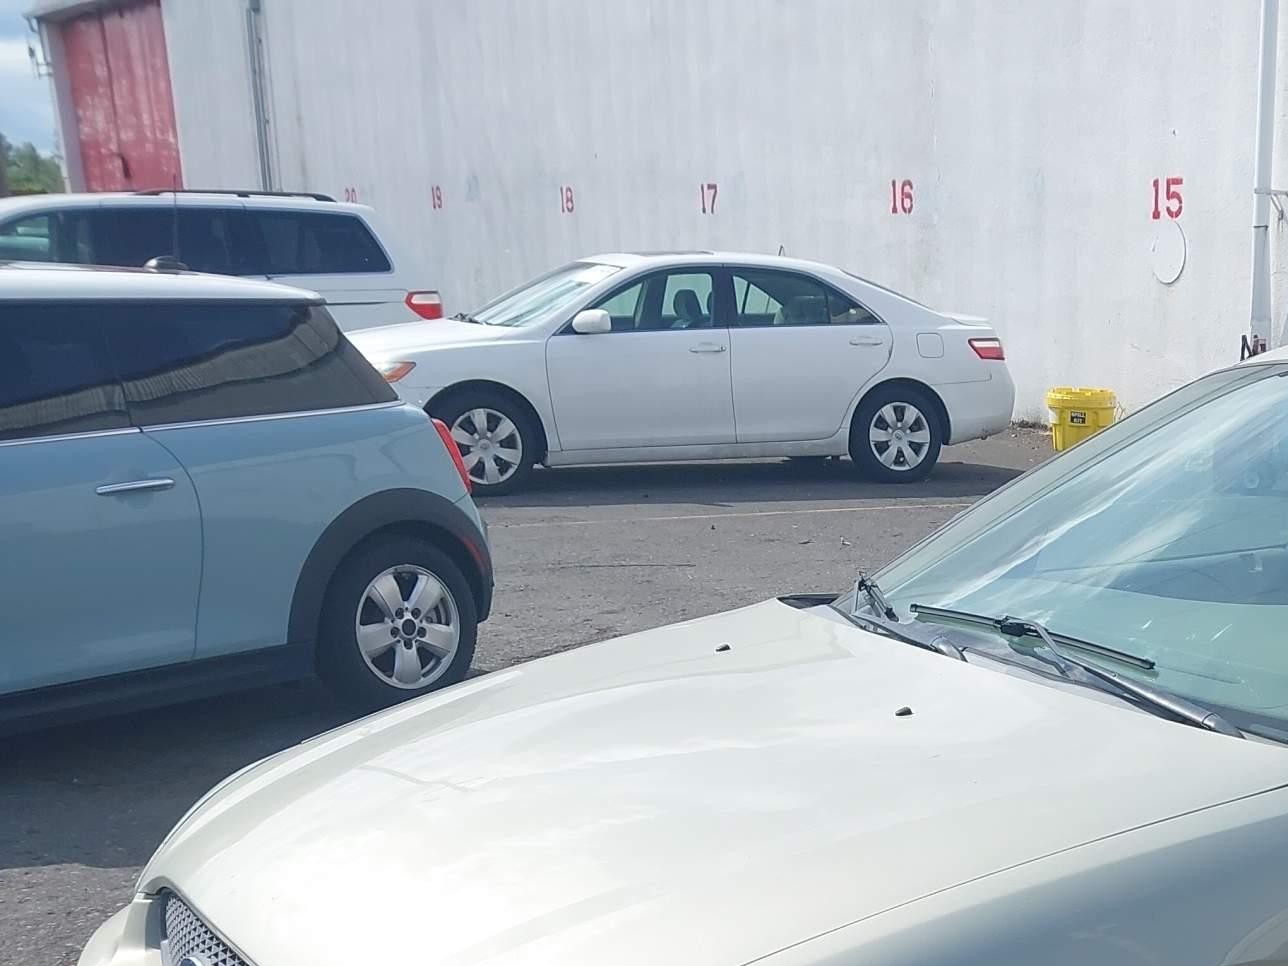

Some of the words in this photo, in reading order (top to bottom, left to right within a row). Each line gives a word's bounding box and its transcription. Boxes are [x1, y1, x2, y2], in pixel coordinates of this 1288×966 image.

[431, 185, 443, 210] 19
[559, 185, 576, 214] 18
[699, 183, 719, 215] 17
[889, 180, 914, 215] 16
[1151, 176, 1185, 221] 15
